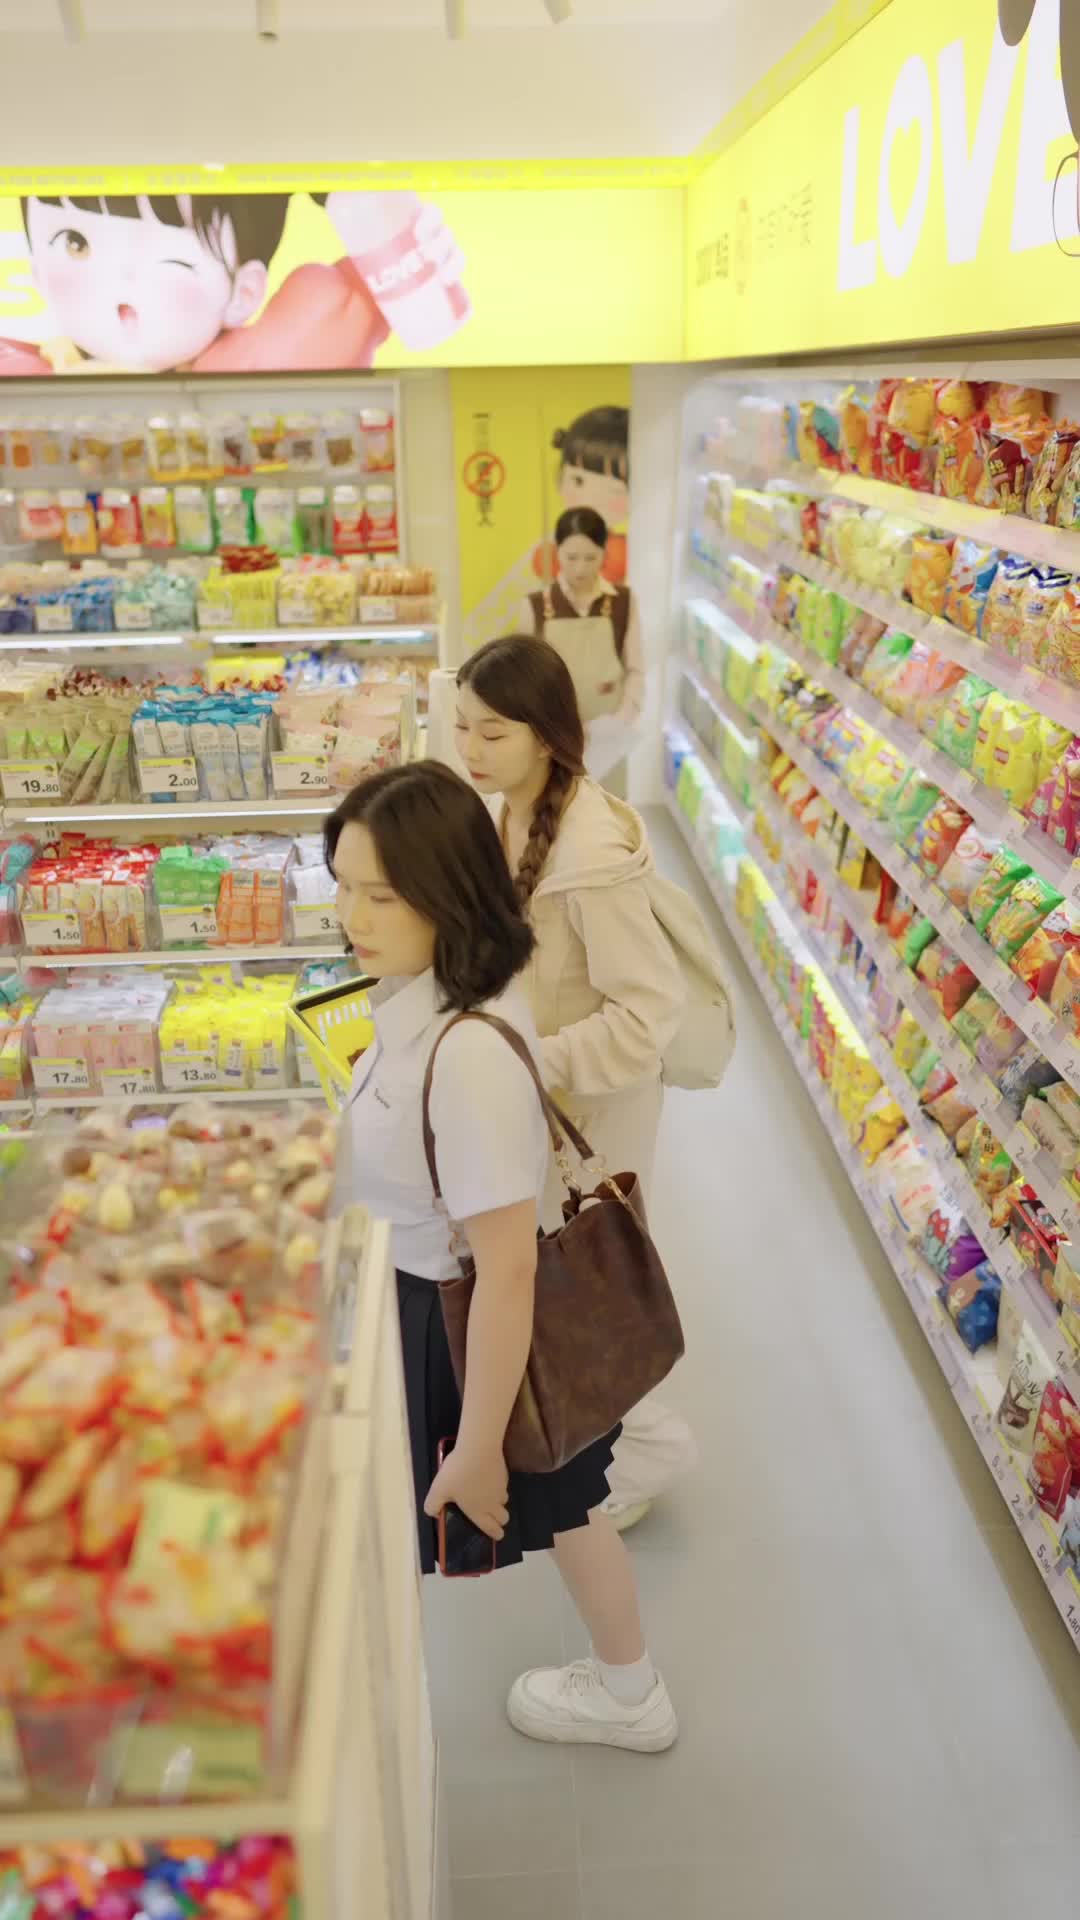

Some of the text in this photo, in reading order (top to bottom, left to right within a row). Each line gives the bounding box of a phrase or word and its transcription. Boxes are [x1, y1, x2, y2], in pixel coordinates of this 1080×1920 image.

[168, 774, 197, 787] 2.00
[300, 771, 328, 785] 2.90
[21, 780, 60, 793] 19.80
[52, 928, 80, 940] 1.50
[52, 1072, 88, 1084] 17.80
[181, 1069, 217, 1081] 13.80
[1066, 1604, 1080, 1635] 1.80
